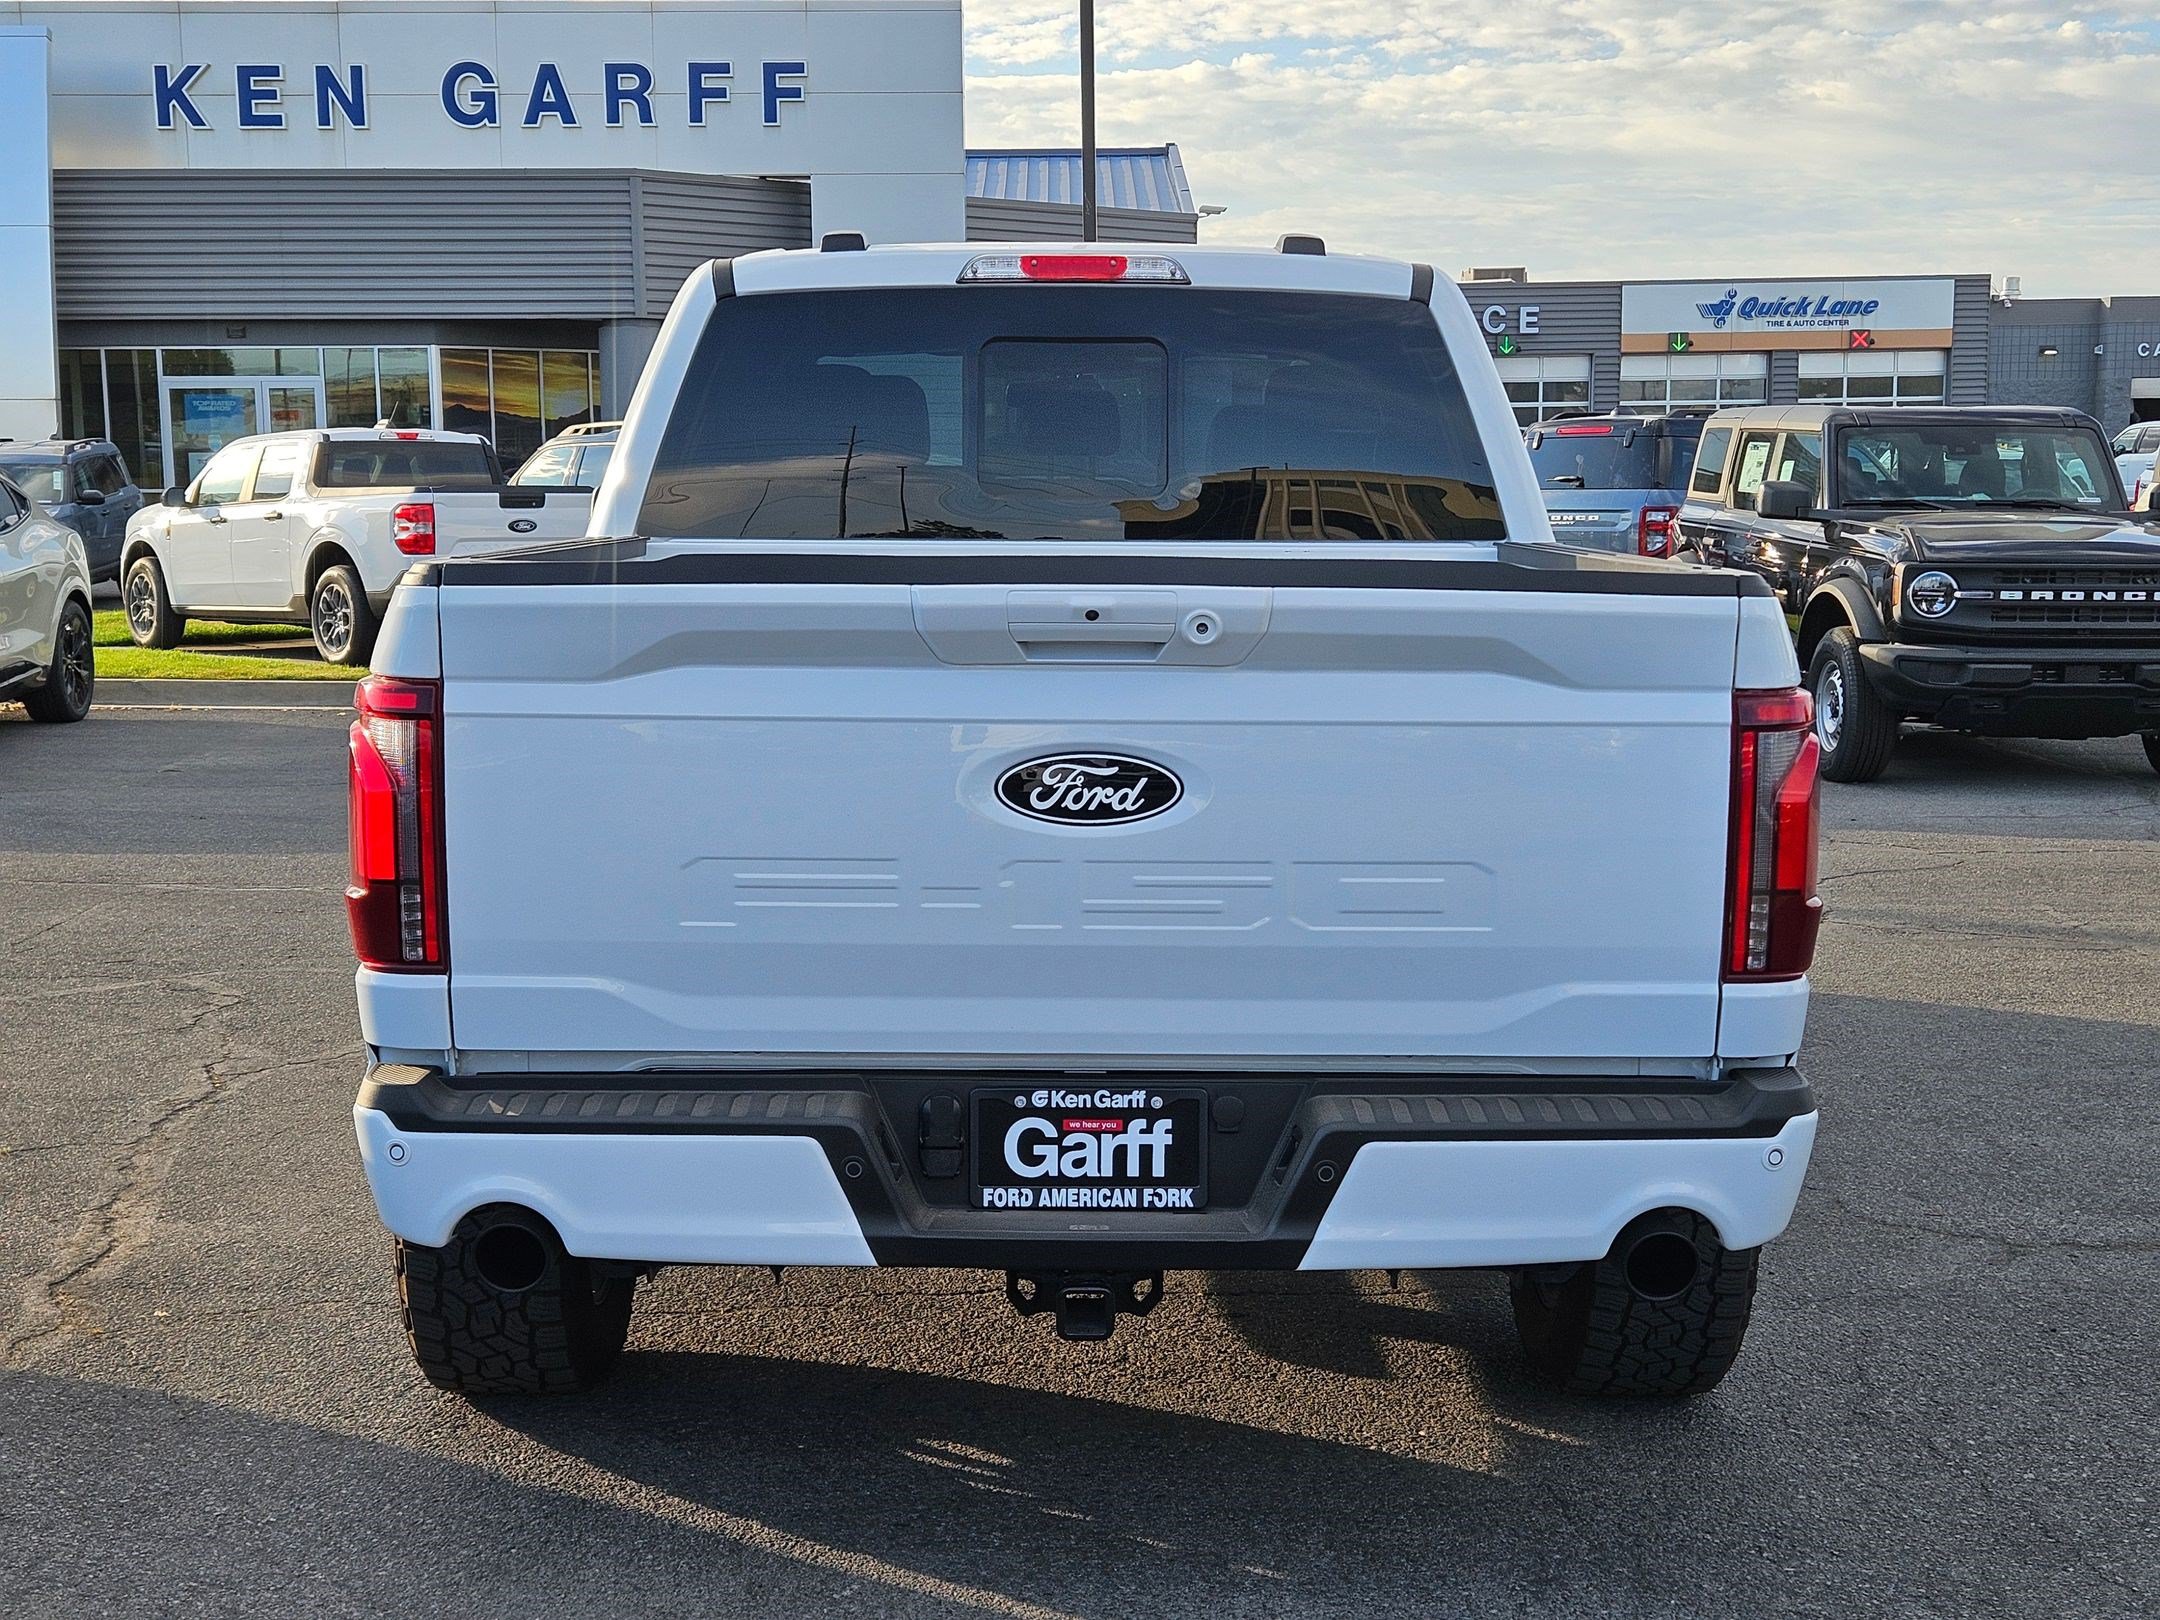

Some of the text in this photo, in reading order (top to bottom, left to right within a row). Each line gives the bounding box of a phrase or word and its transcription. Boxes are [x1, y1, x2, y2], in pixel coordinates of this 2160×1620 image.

[152, 60, 809, 130] KEN GARFF
[1482, 305, 1540, 334] CE
[1738, 295, 1880, 320] Quick Lane
[1793, 319, 1815, 327] AUTO
[1029, 763, 1149, 812] Ford
[679, 856, 1497, 933] F-150
[1051, 1090, 1092, 1108] Ken
[1093, 1089, 1147, 1108] Garff
[1082, 1120, 1101, 1128] hear
[1101, 1122, 1117, 1130] you
[1003, 1116, 1173, 1179] Garff
[982, 1187, 1194, 1208] FORD AMERICAN FORK
